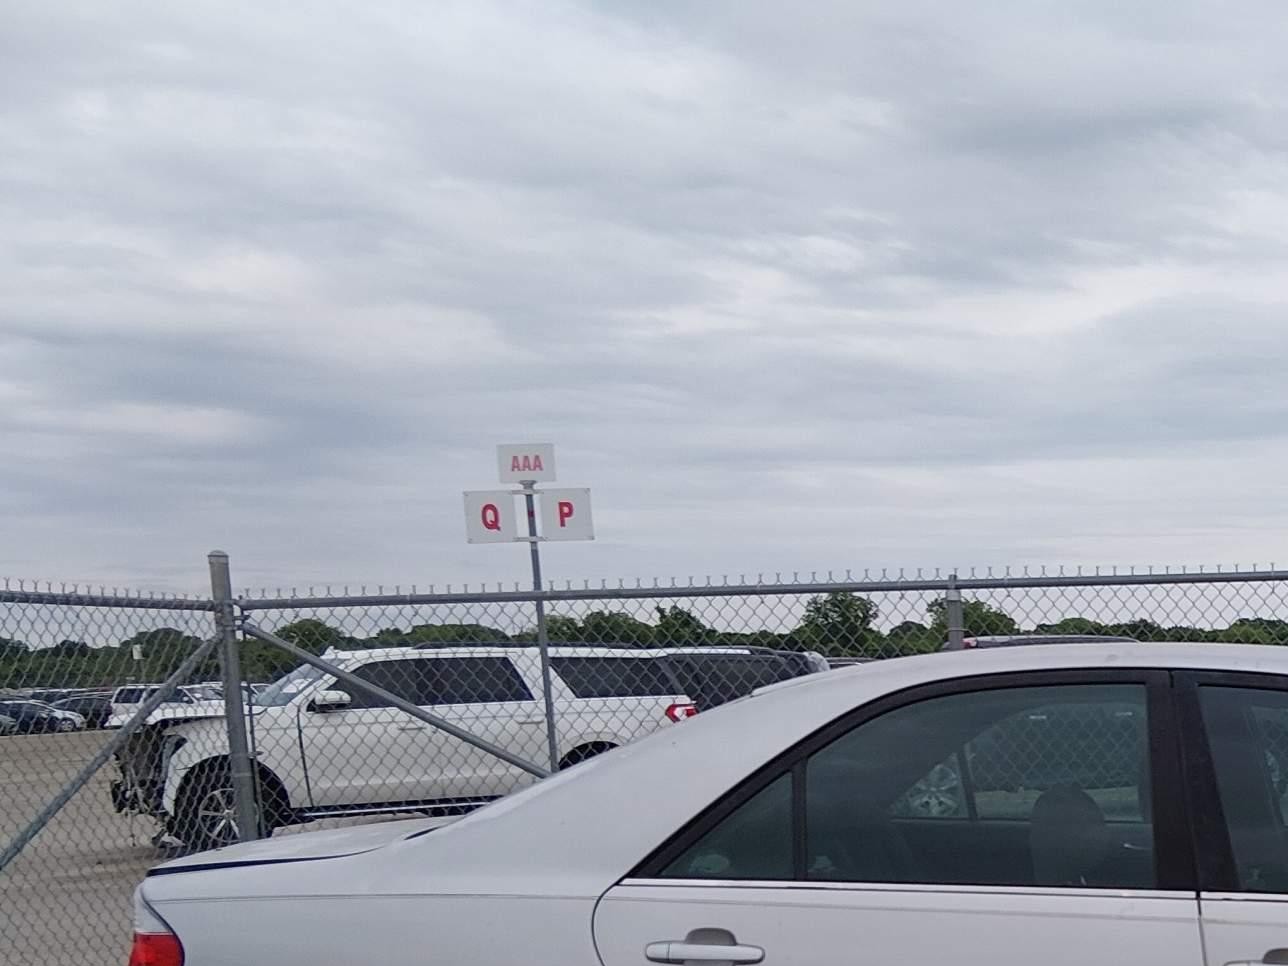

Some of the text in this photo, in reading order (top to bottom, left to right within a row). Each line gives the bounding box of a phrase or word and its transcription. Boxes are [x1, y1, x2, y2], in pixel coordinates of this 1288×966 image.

[511, 455, 543, 472] AAA
[481, 504, 501, 531] Q
[558, 502, 574, 527] P
